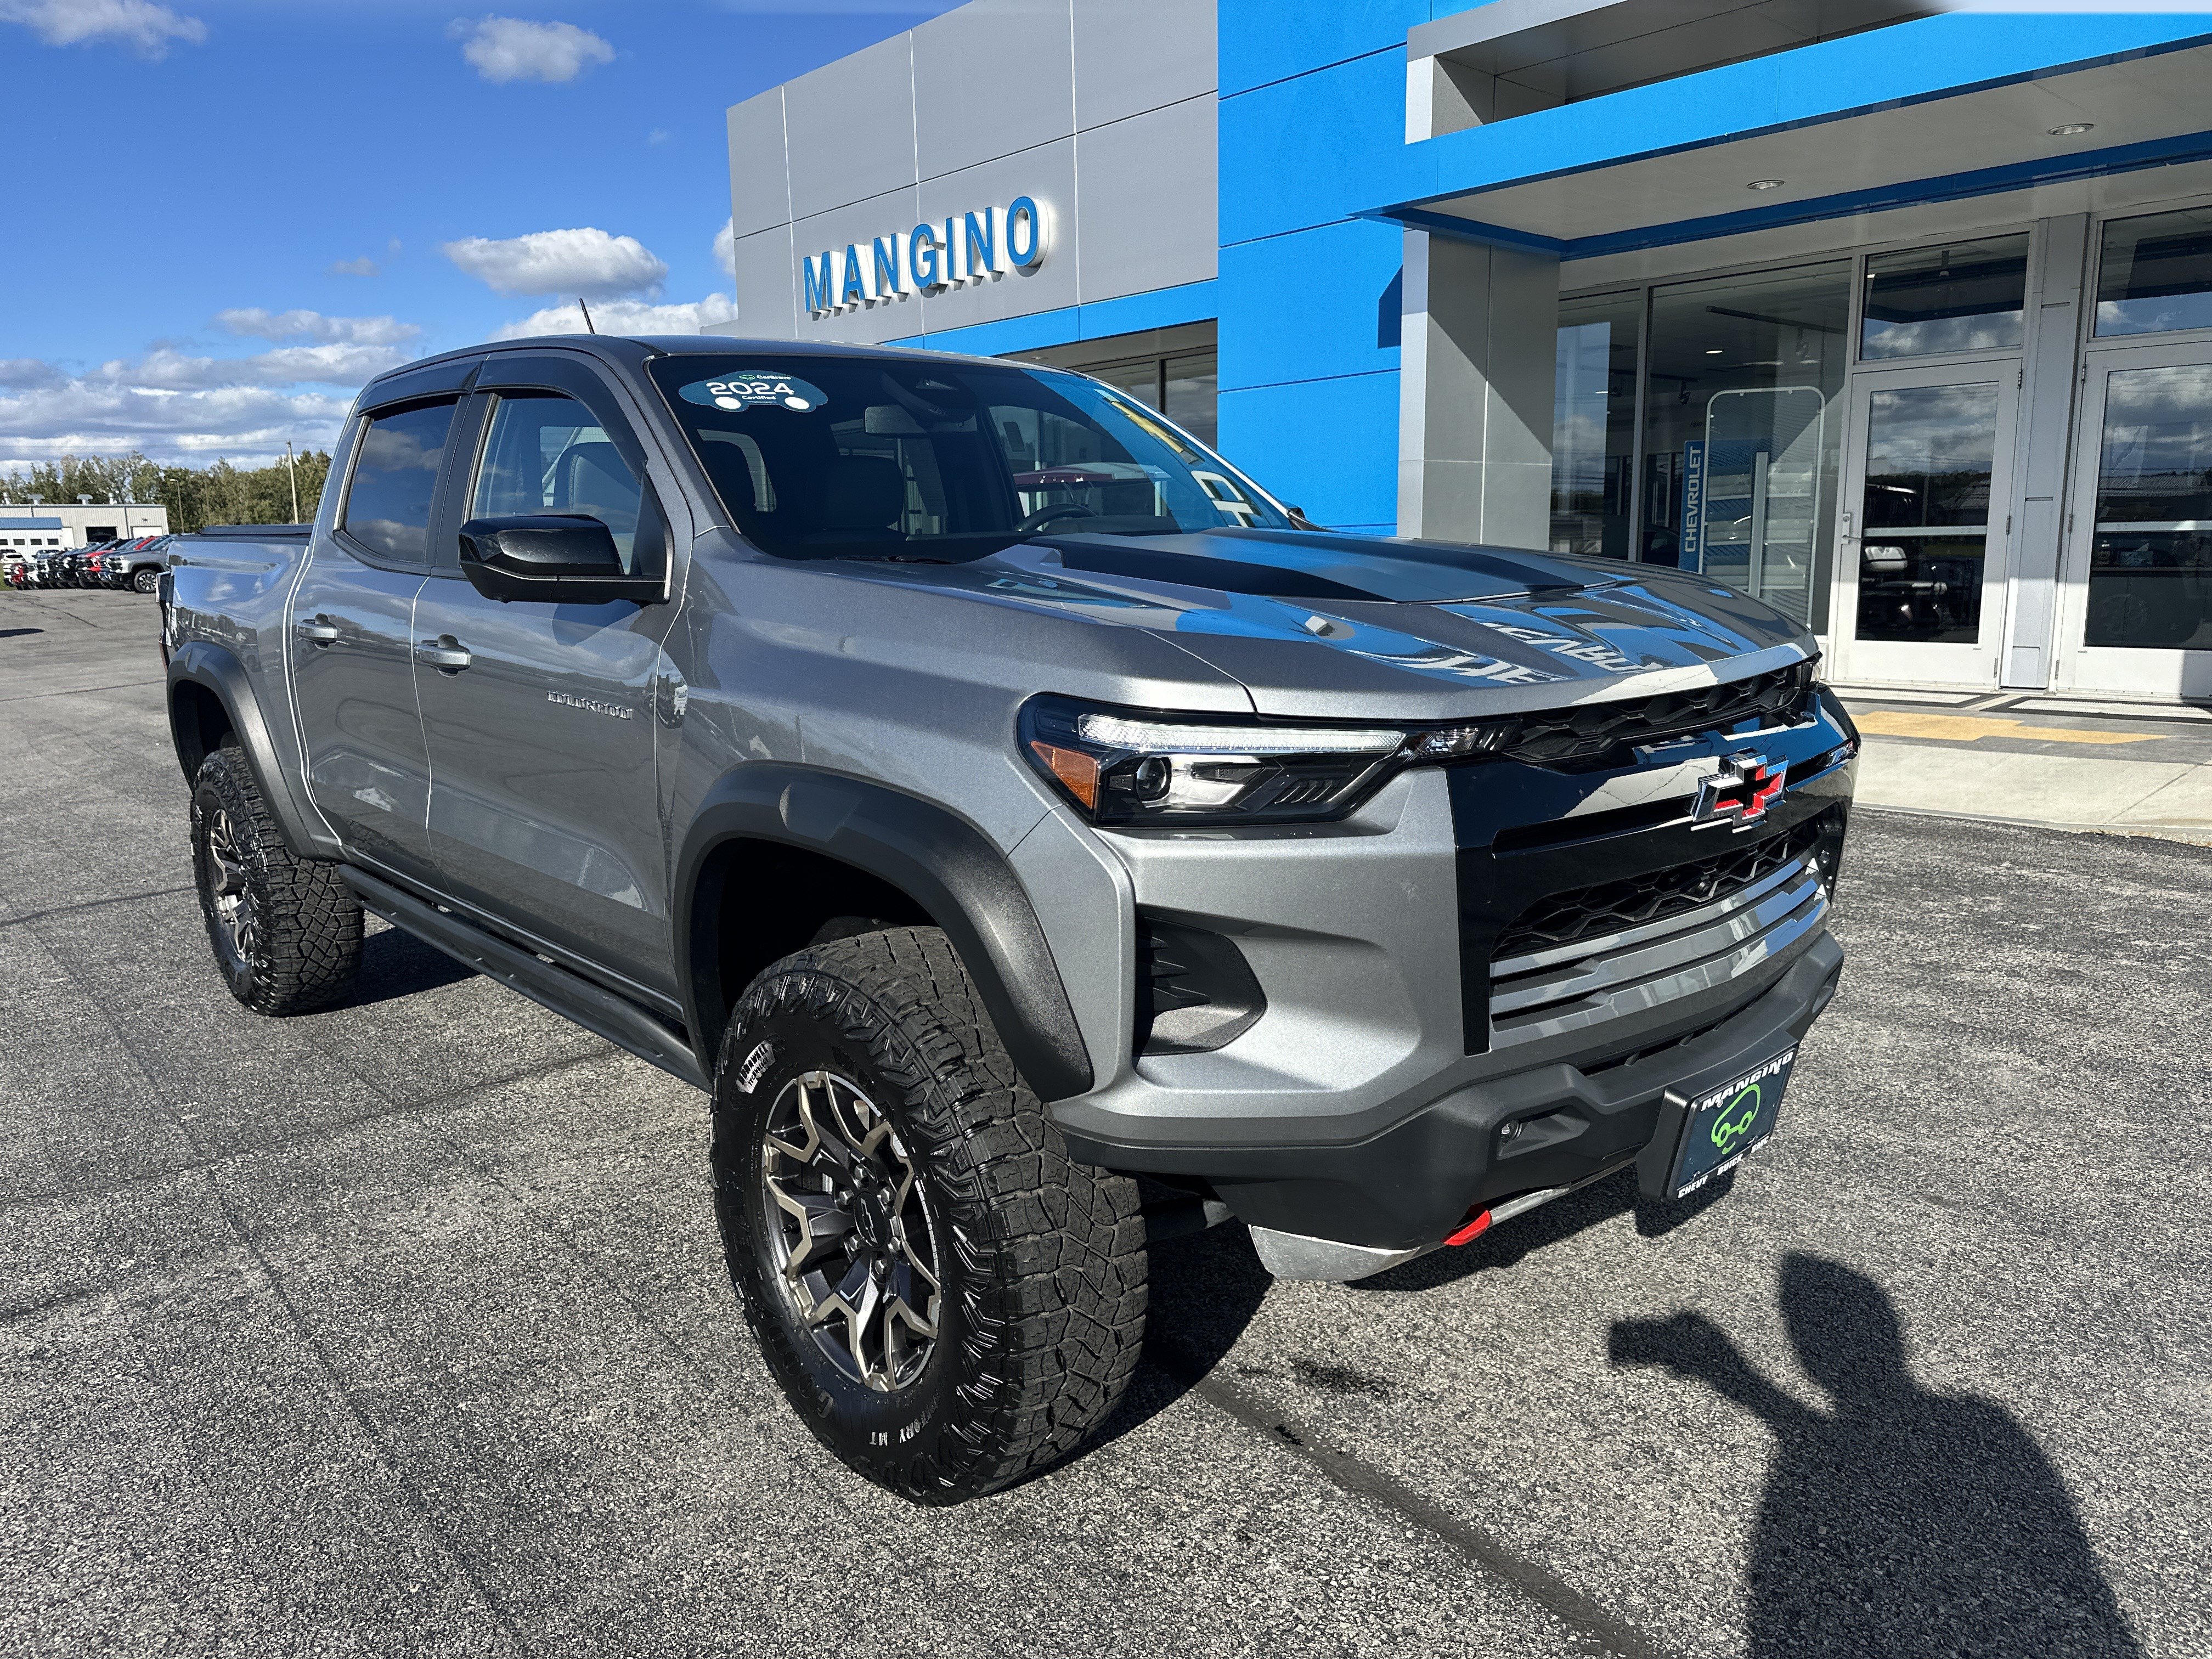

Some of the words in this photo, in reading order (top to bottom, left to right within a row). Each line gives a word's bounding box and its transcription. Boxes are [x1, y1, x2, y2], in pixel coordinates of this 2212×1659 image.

[803, 196, 1048, 313] MANGINO
[706, 382, 794, 394] 2024
[1684, 446, 1701, 552] CHEVROLET
[1701, 1052, 1793, 1111] MANGINO
[1678, 1175, 1708, 1198] CHEVY
[1717, 1154, 1743, 1176] BUICK
[869, 1431, 888, 1446] MT
